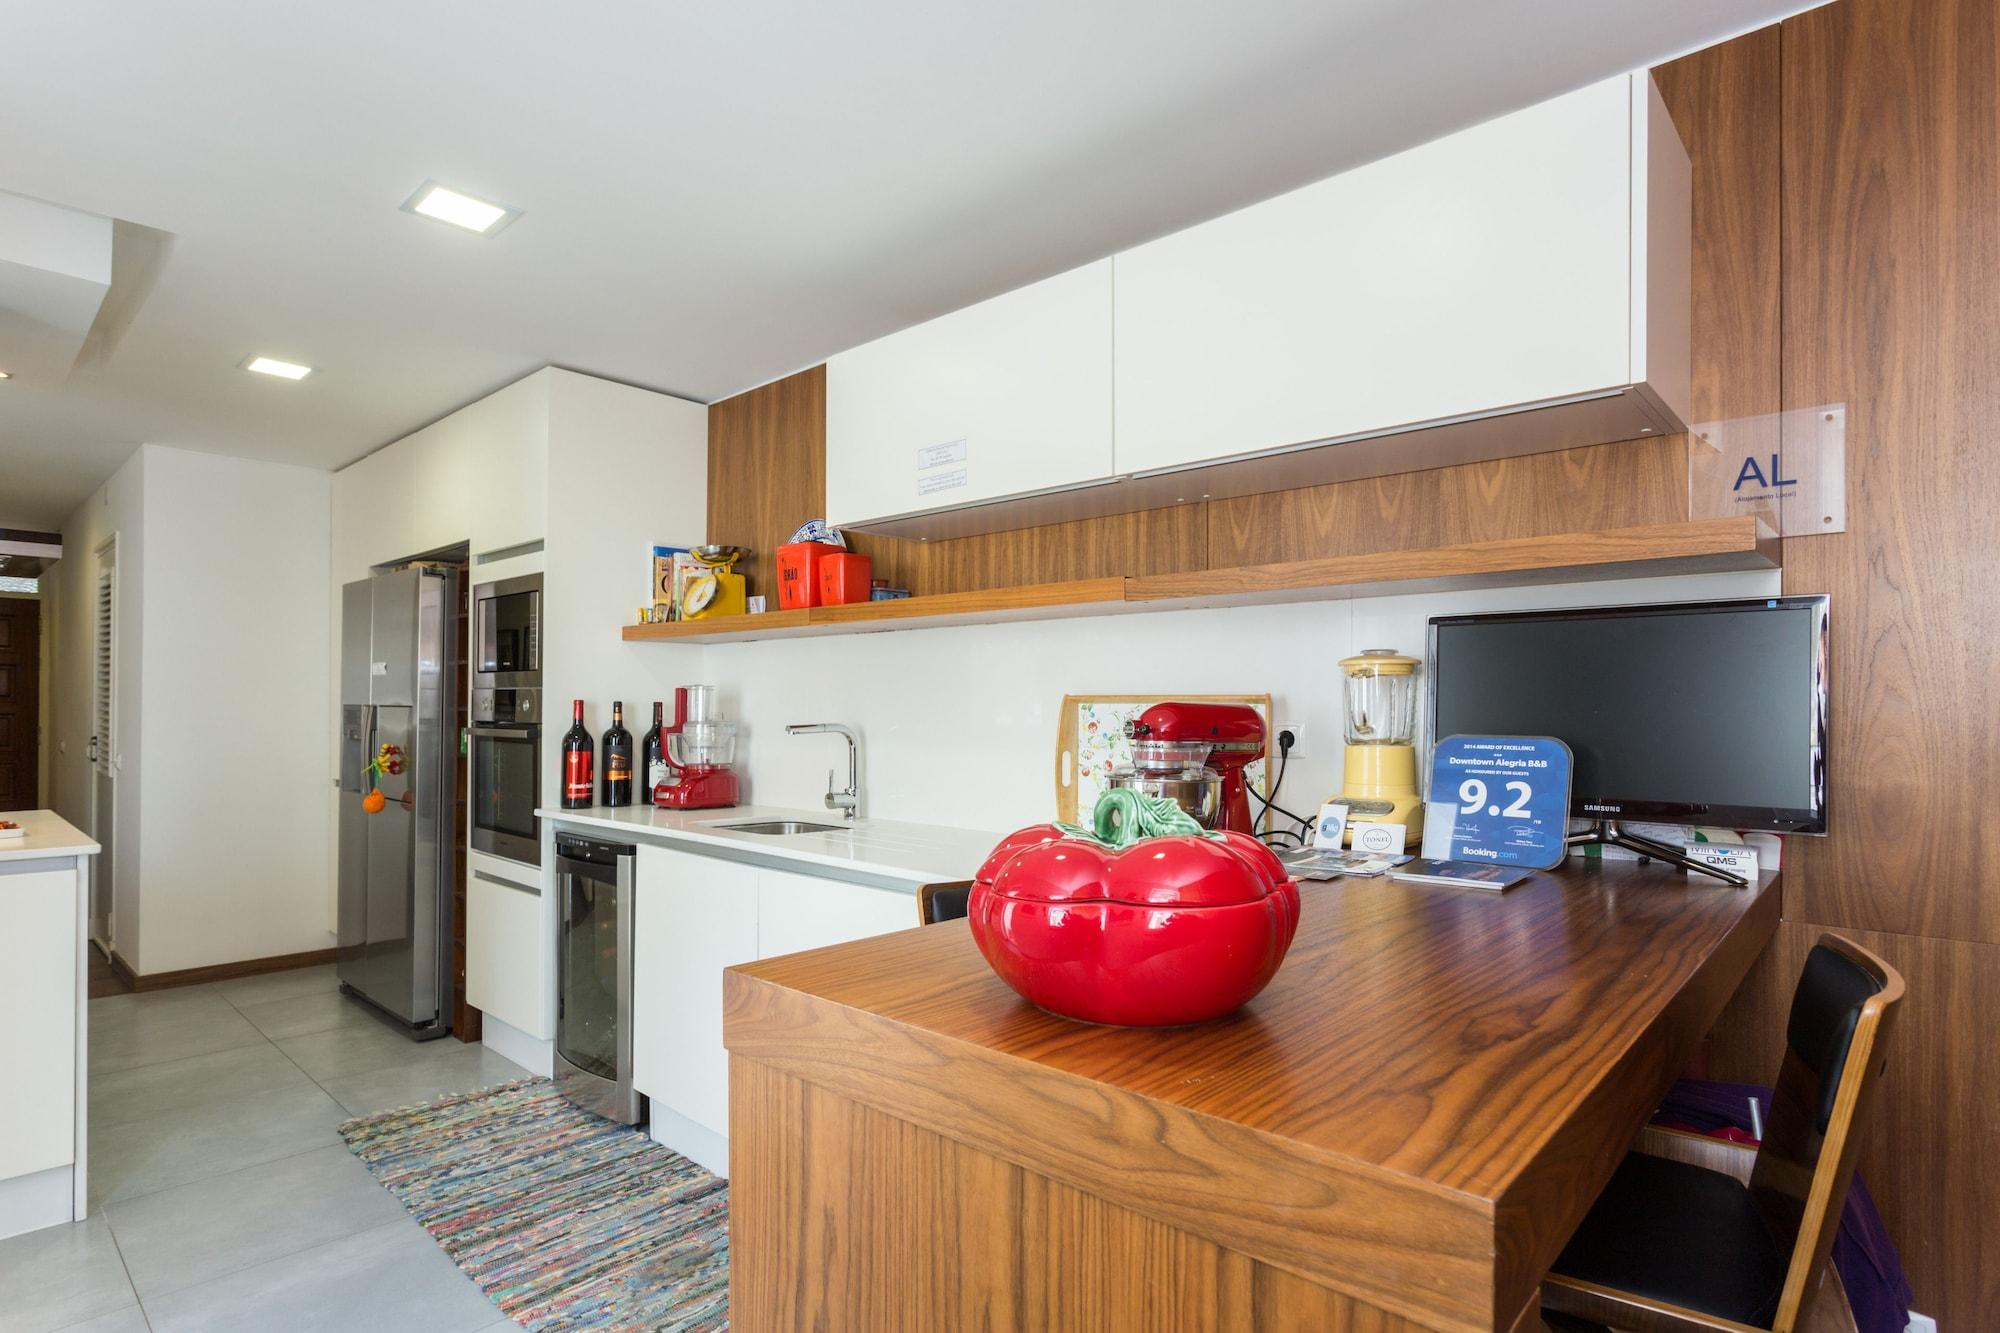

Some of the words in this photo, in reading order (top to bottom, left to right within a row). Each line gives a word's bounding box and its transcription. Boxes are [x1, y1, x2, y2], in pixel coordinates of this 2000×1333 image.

[1733, 453, 1797, 491] AL
[1449, 757, 1494, 766] Downtown
[1495, 758, 1527, 768] Alegria
[1528, 760, 1548, 768] B&B
[1458, 779, 1532, 818] 9.2
[1584, 804, 1621, 813] SAMSUNG
[1463, 846, 1518, 859] Booking.com
[1706, 856, 1737, 866] QMS
